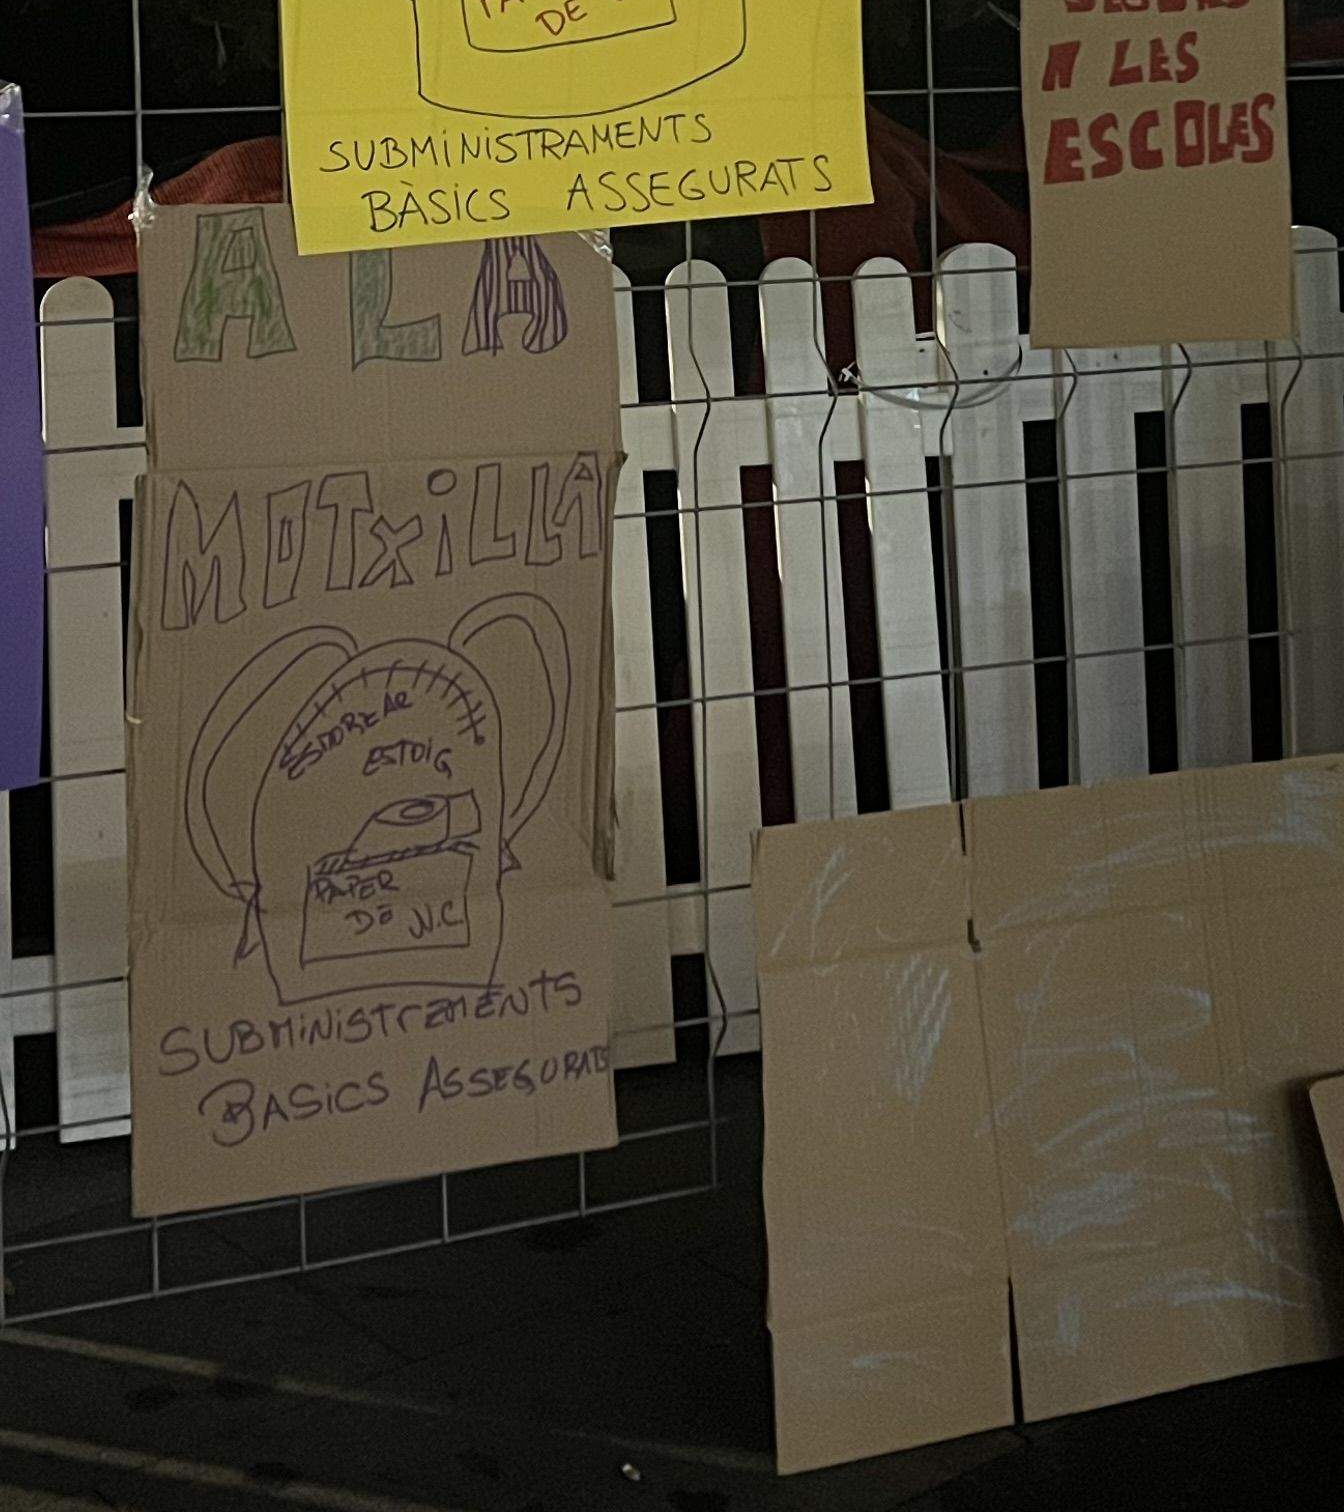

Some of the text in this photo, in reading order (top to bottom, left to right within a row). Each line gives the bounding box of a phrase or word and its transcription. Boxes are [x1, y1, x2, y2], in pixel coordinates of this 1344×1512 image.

[1108, 29, 1201, 87] LES
[319, 111, 715, 175] SUBMINISTRAMENTS
[1043, 91, 1277, 186] ESCOLES
[360, 152, 834, 234] BÀSICS ASSEGURATS
[173, 205, 569, 374] A LA
[160, 450, 604, 632] MOTXILLA
[362, 737, 454, 780] ESTOIG
[311, 869, 399, 904] PAPER
